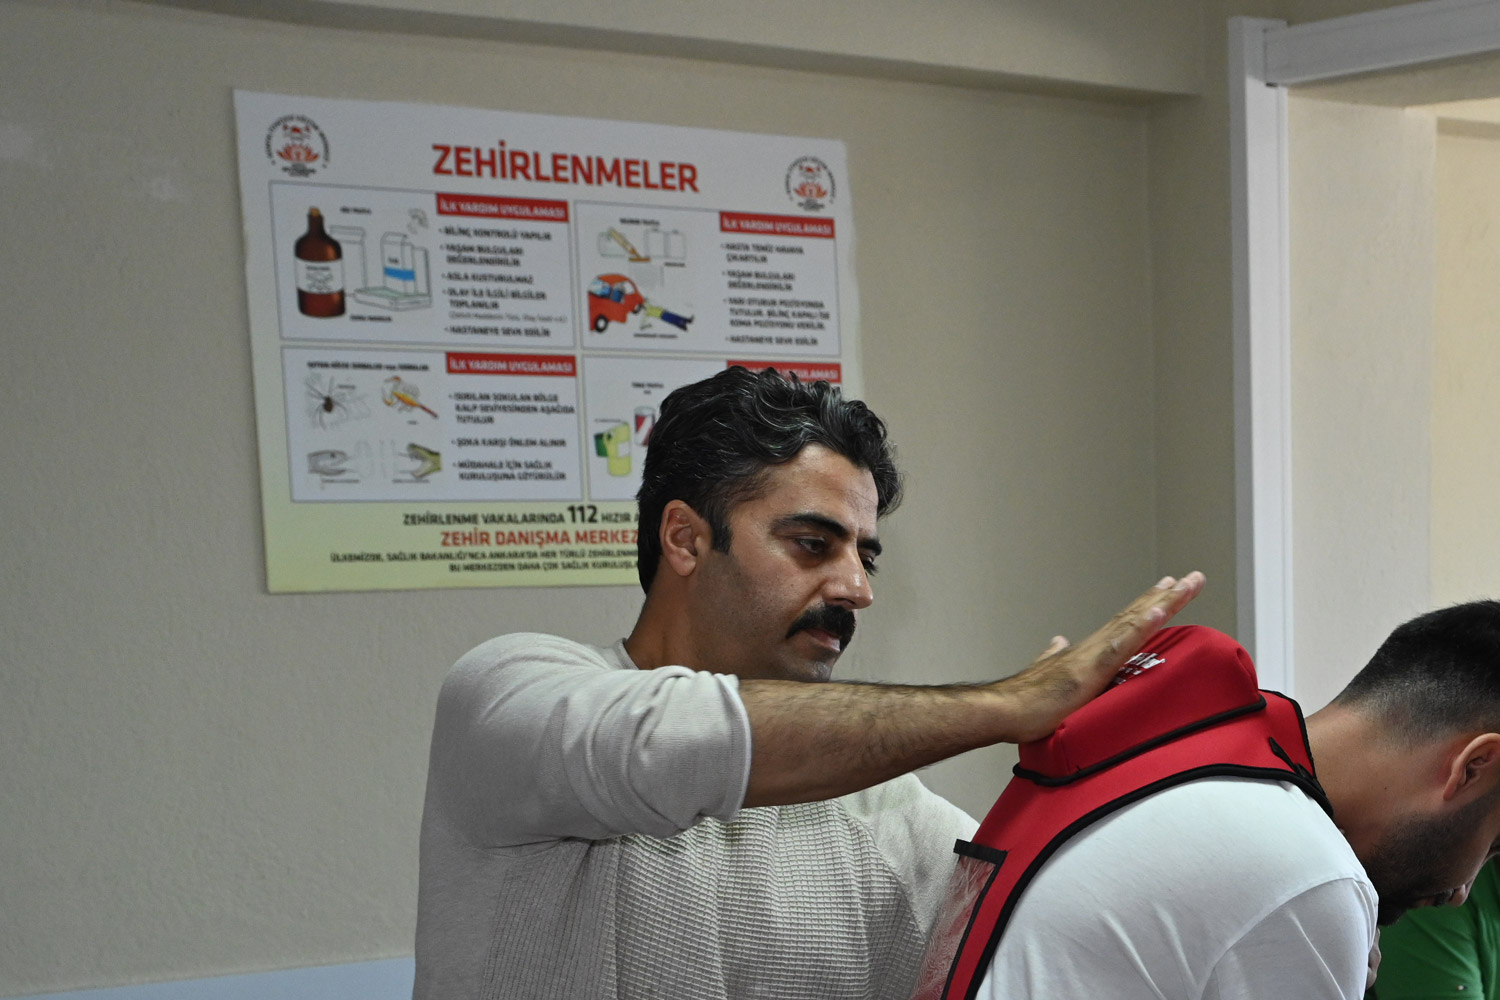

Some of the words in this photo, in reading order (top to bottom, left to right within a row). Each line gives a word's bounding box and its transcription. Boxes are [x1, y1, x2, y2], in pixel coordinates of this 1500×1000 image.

[432, 140, 699, 194] ZEHİRLENMELER
[403, 510, 479, 526] ZEHİRLENME
[481, 512, 565, 525] VAKALARINDA
[567, 504, 598, 524] 112
[601, 512, 631, 523] HIZIR
[441, 527, 491, 547] ZEHİR
[495, 529, 570, 549] DANIŞMA
